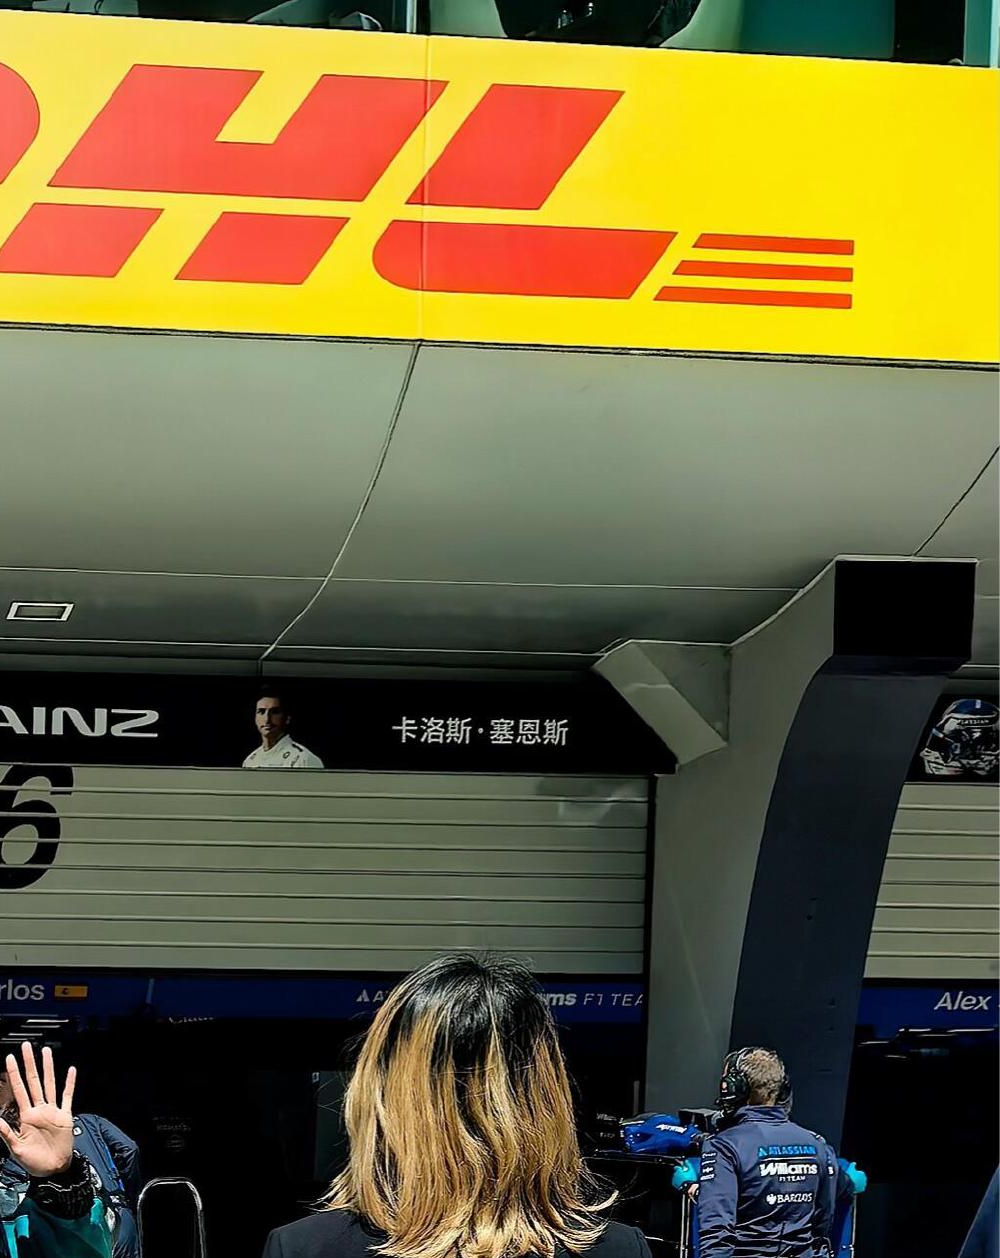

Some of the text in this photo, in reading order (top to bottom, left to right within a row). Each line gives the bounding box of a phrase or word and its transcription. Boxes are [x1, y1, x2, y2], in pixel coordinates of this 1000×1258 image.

[391, 715, 569, 746] 卡洛斯·塞恩斯
[933, 990, 993, 1011] Alex
[768, 1145, 816, 1156] ATLASSIAN
[760, 1162, 818, 1177] Williams
